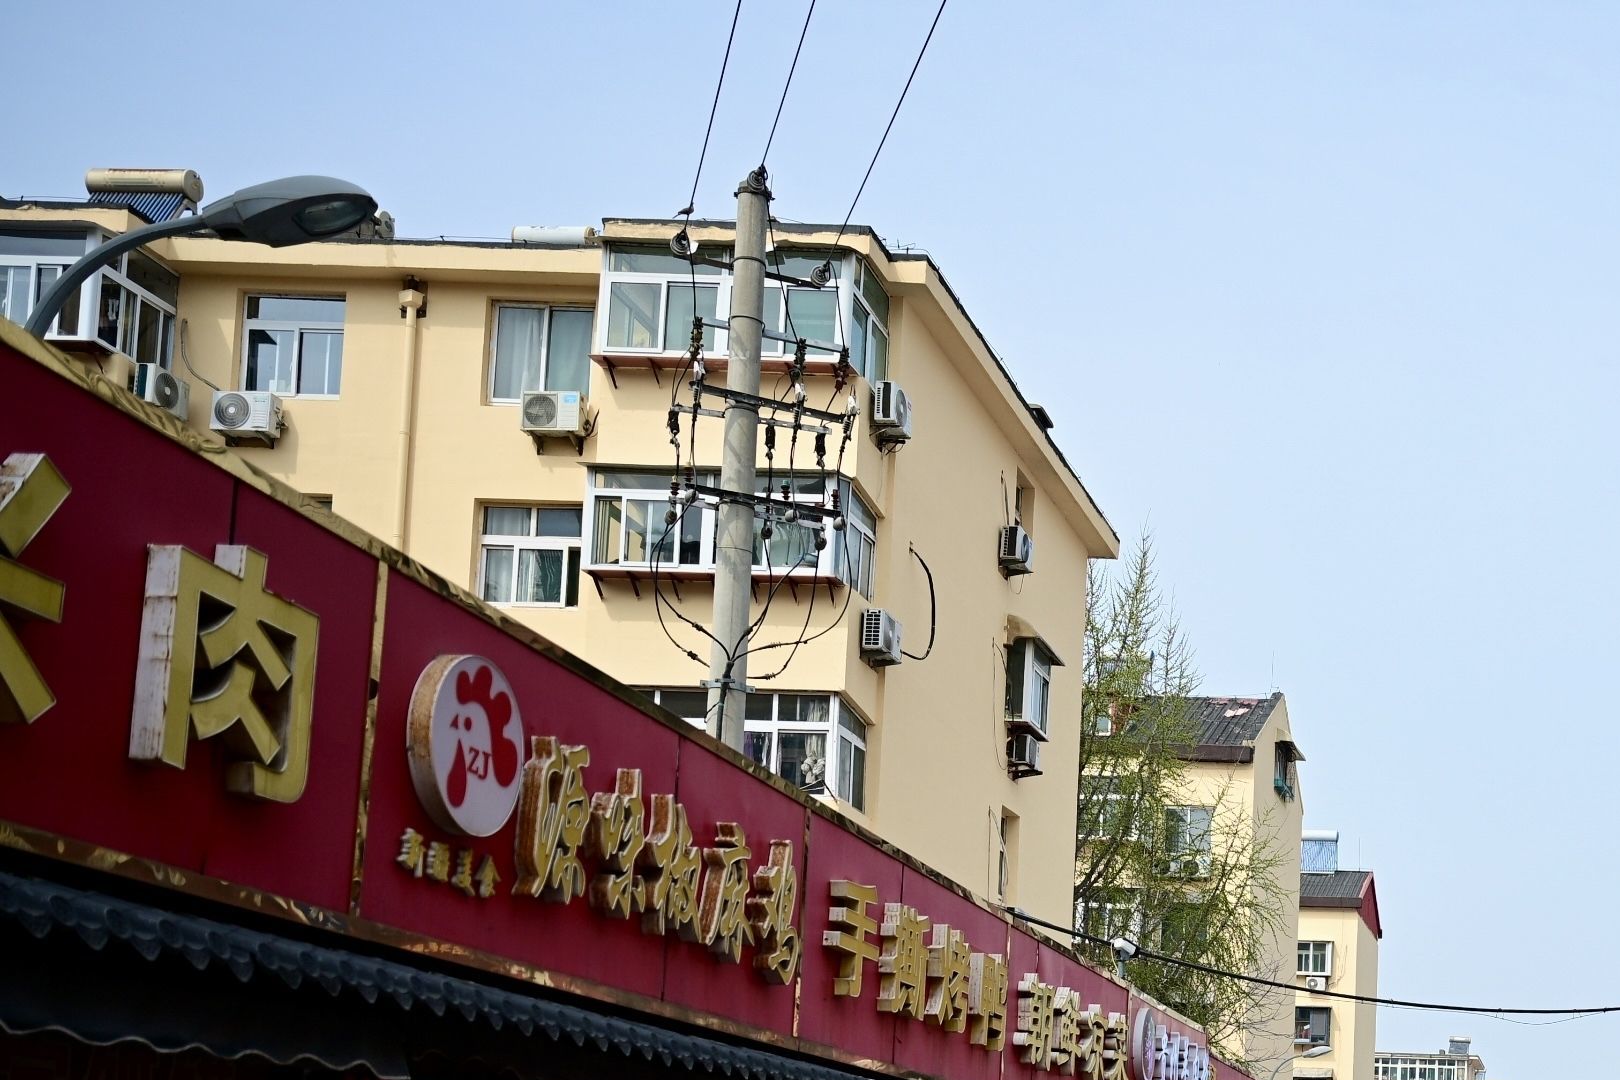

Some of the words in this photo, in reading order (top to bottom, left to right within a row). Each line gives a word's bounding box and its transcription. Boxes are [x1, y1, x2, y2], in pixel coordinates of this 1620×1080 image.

[469, 747, 492, 780] ZJ
[823, 879, 1007, 1053] 手撕烤鸭
